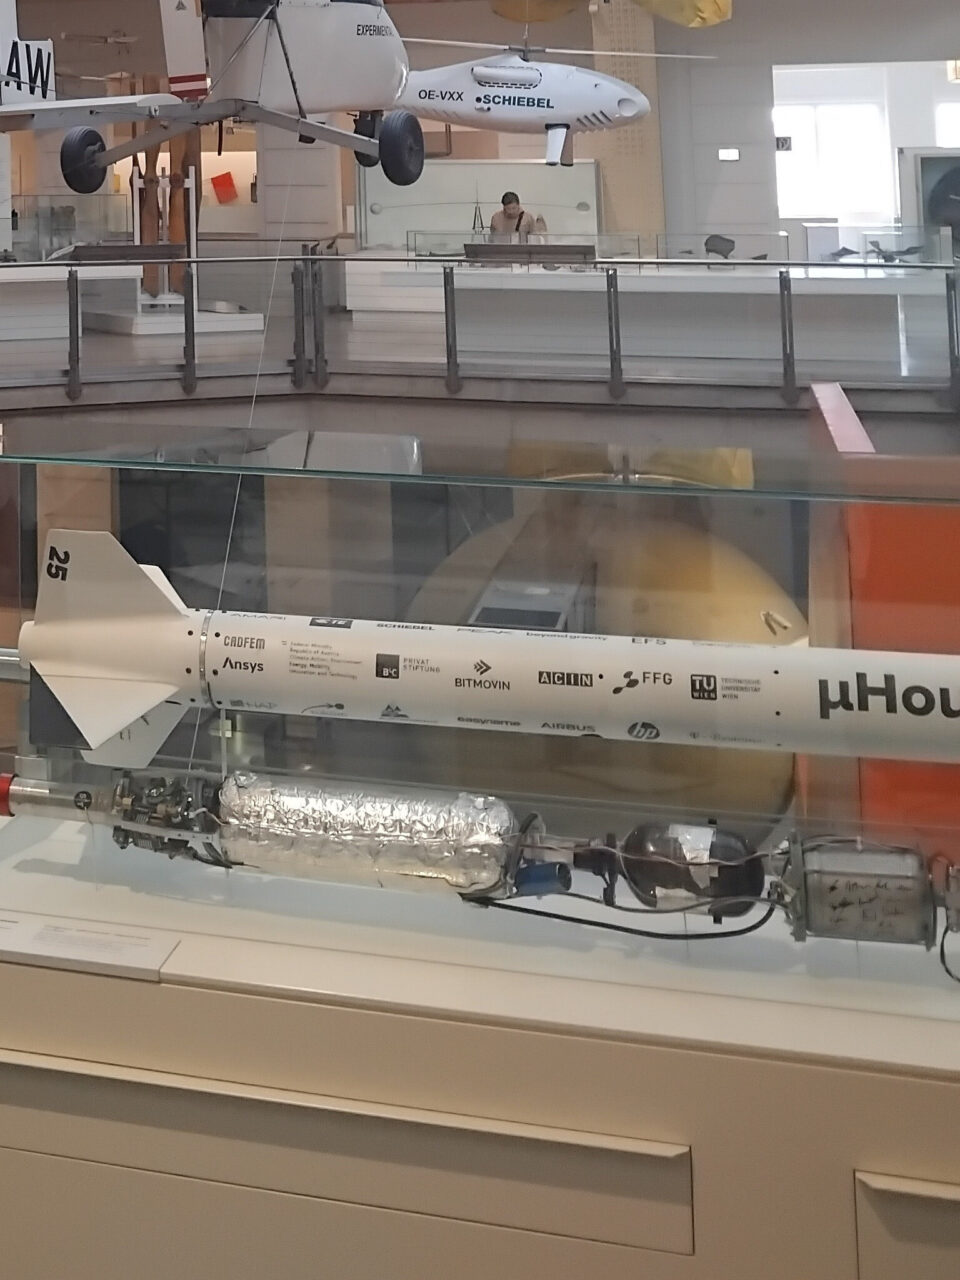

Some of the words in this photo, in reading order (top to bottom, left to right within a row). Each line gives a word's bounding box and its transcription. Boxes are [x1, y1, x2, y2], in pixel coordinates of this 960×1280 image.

[418, 89, 464, 101] OE-VXX
[483, 94, 555, 109] SCHIEBEL
[47, 545, 70, 582] 25
[223, 635, 266, 650] CADFEM
[222, 657, 264, 674] Ansys
[403, 657, 429, 665] PRIVAT
[402, 664, 440, 673] STIFTUNG
[454, 677, 511, 691] BITMOVIN
[540, 672, 592, 687] ACIN
[642, 672, 673, 686] FFG
[692, 675, 715, 690] TU
[541, 721, 596, 733] AIRBUS
